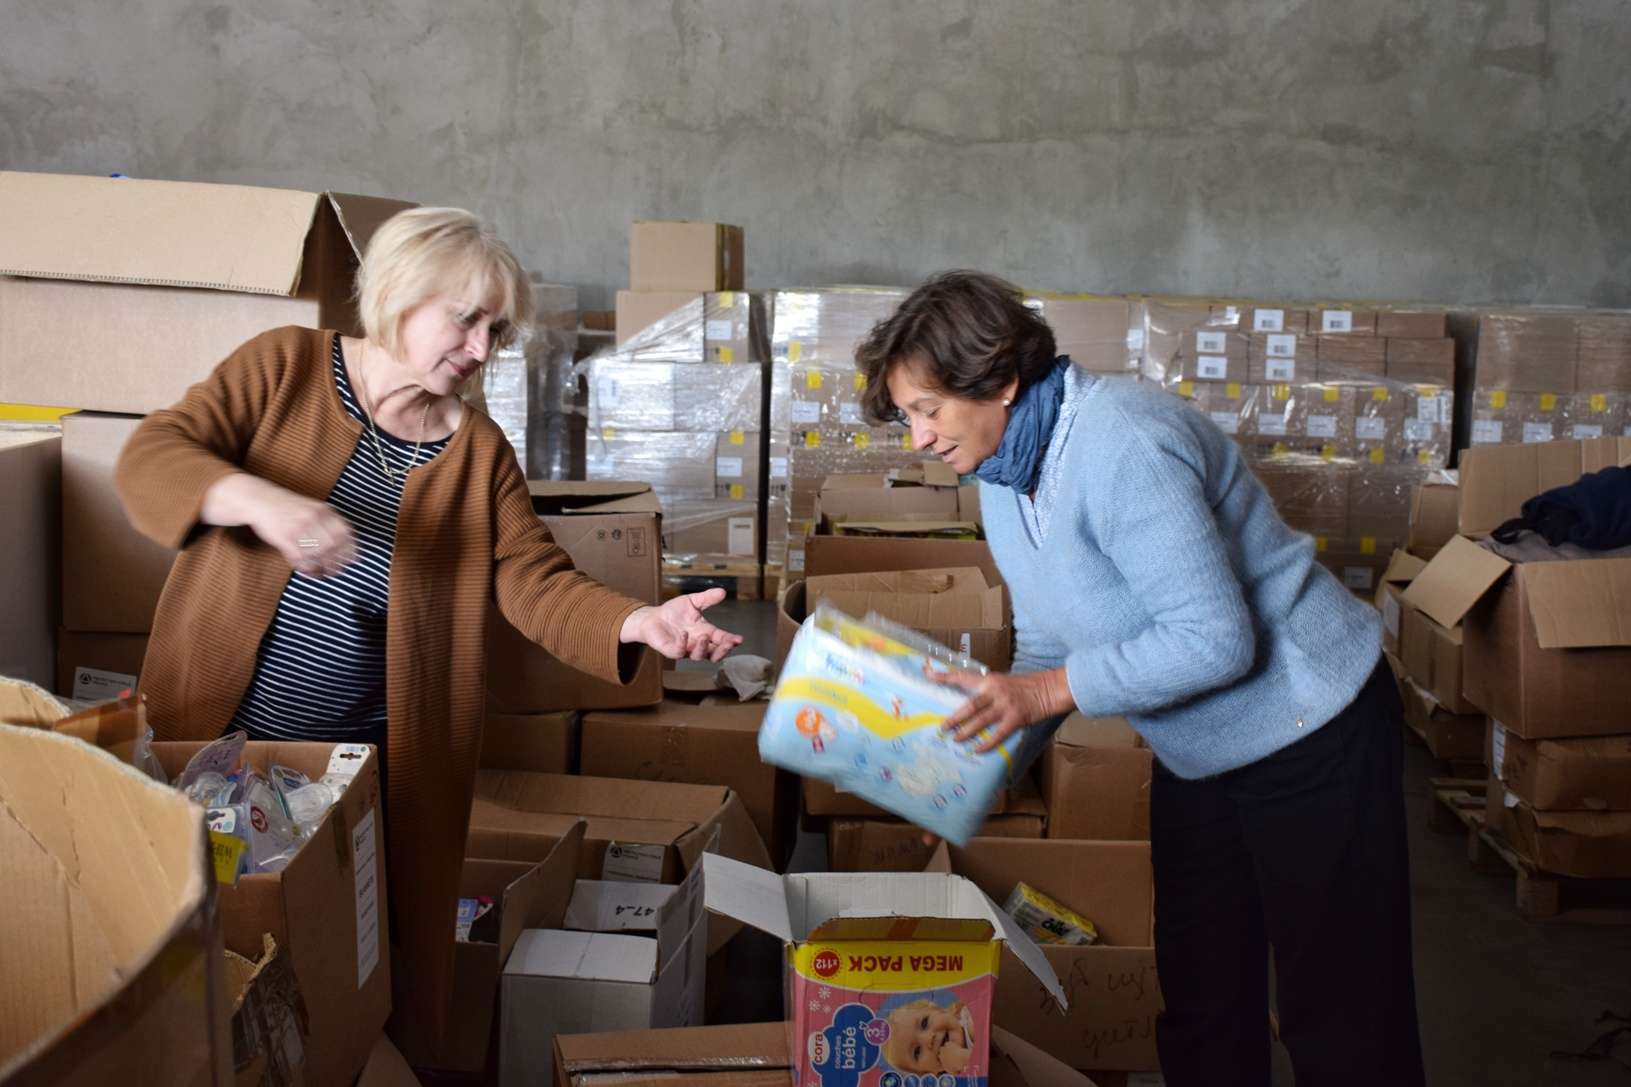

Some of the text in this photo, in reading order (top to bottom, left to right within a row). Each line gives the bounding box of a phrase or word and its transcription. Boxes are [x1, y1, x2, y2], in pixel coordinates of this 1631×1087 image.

[815, 957, 838, 969] x112
[848, 955, 963, 972] MEGA PACK
[867, 1025, 881, 1038] 3
[814, 1033, 824, 1063] cora
[842, 1026, 856, 1069] bébé
